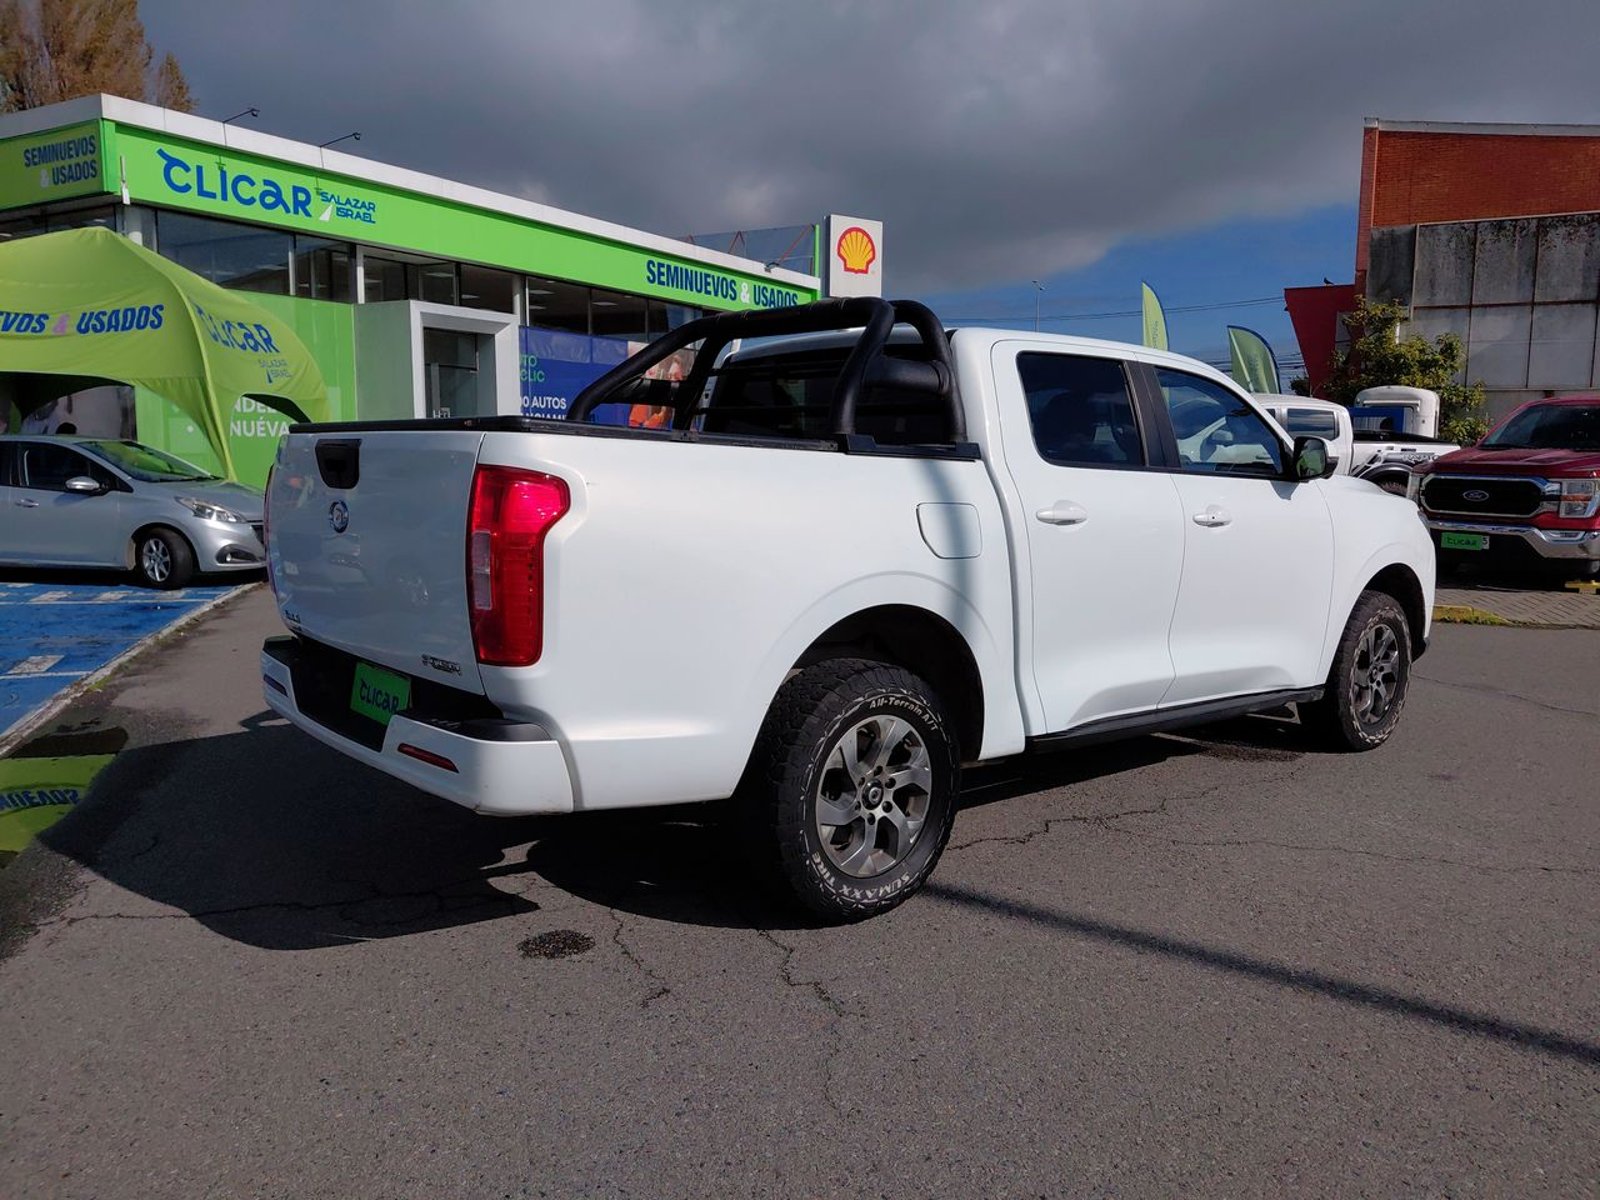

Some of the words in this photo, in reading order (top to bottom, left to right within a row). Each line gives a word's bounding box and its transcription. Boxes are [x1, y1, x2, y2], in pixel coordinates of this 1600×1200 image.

[23, 134, 97, 167] SEMINUEVOS
[52, 159, 98, 185] USADOS
[320, 191, 376, 213] SALAZAR
[336, 207, 377, 225] ISRAEL
[646, 259, 738, 301] SEMINUEVOS
[740, 281, 751, 304] &
[76, 304, 165, 335] USADOS
[531, 396, 567, 410] AUTOS
[839, 872, 911, 900] SUMAXX
